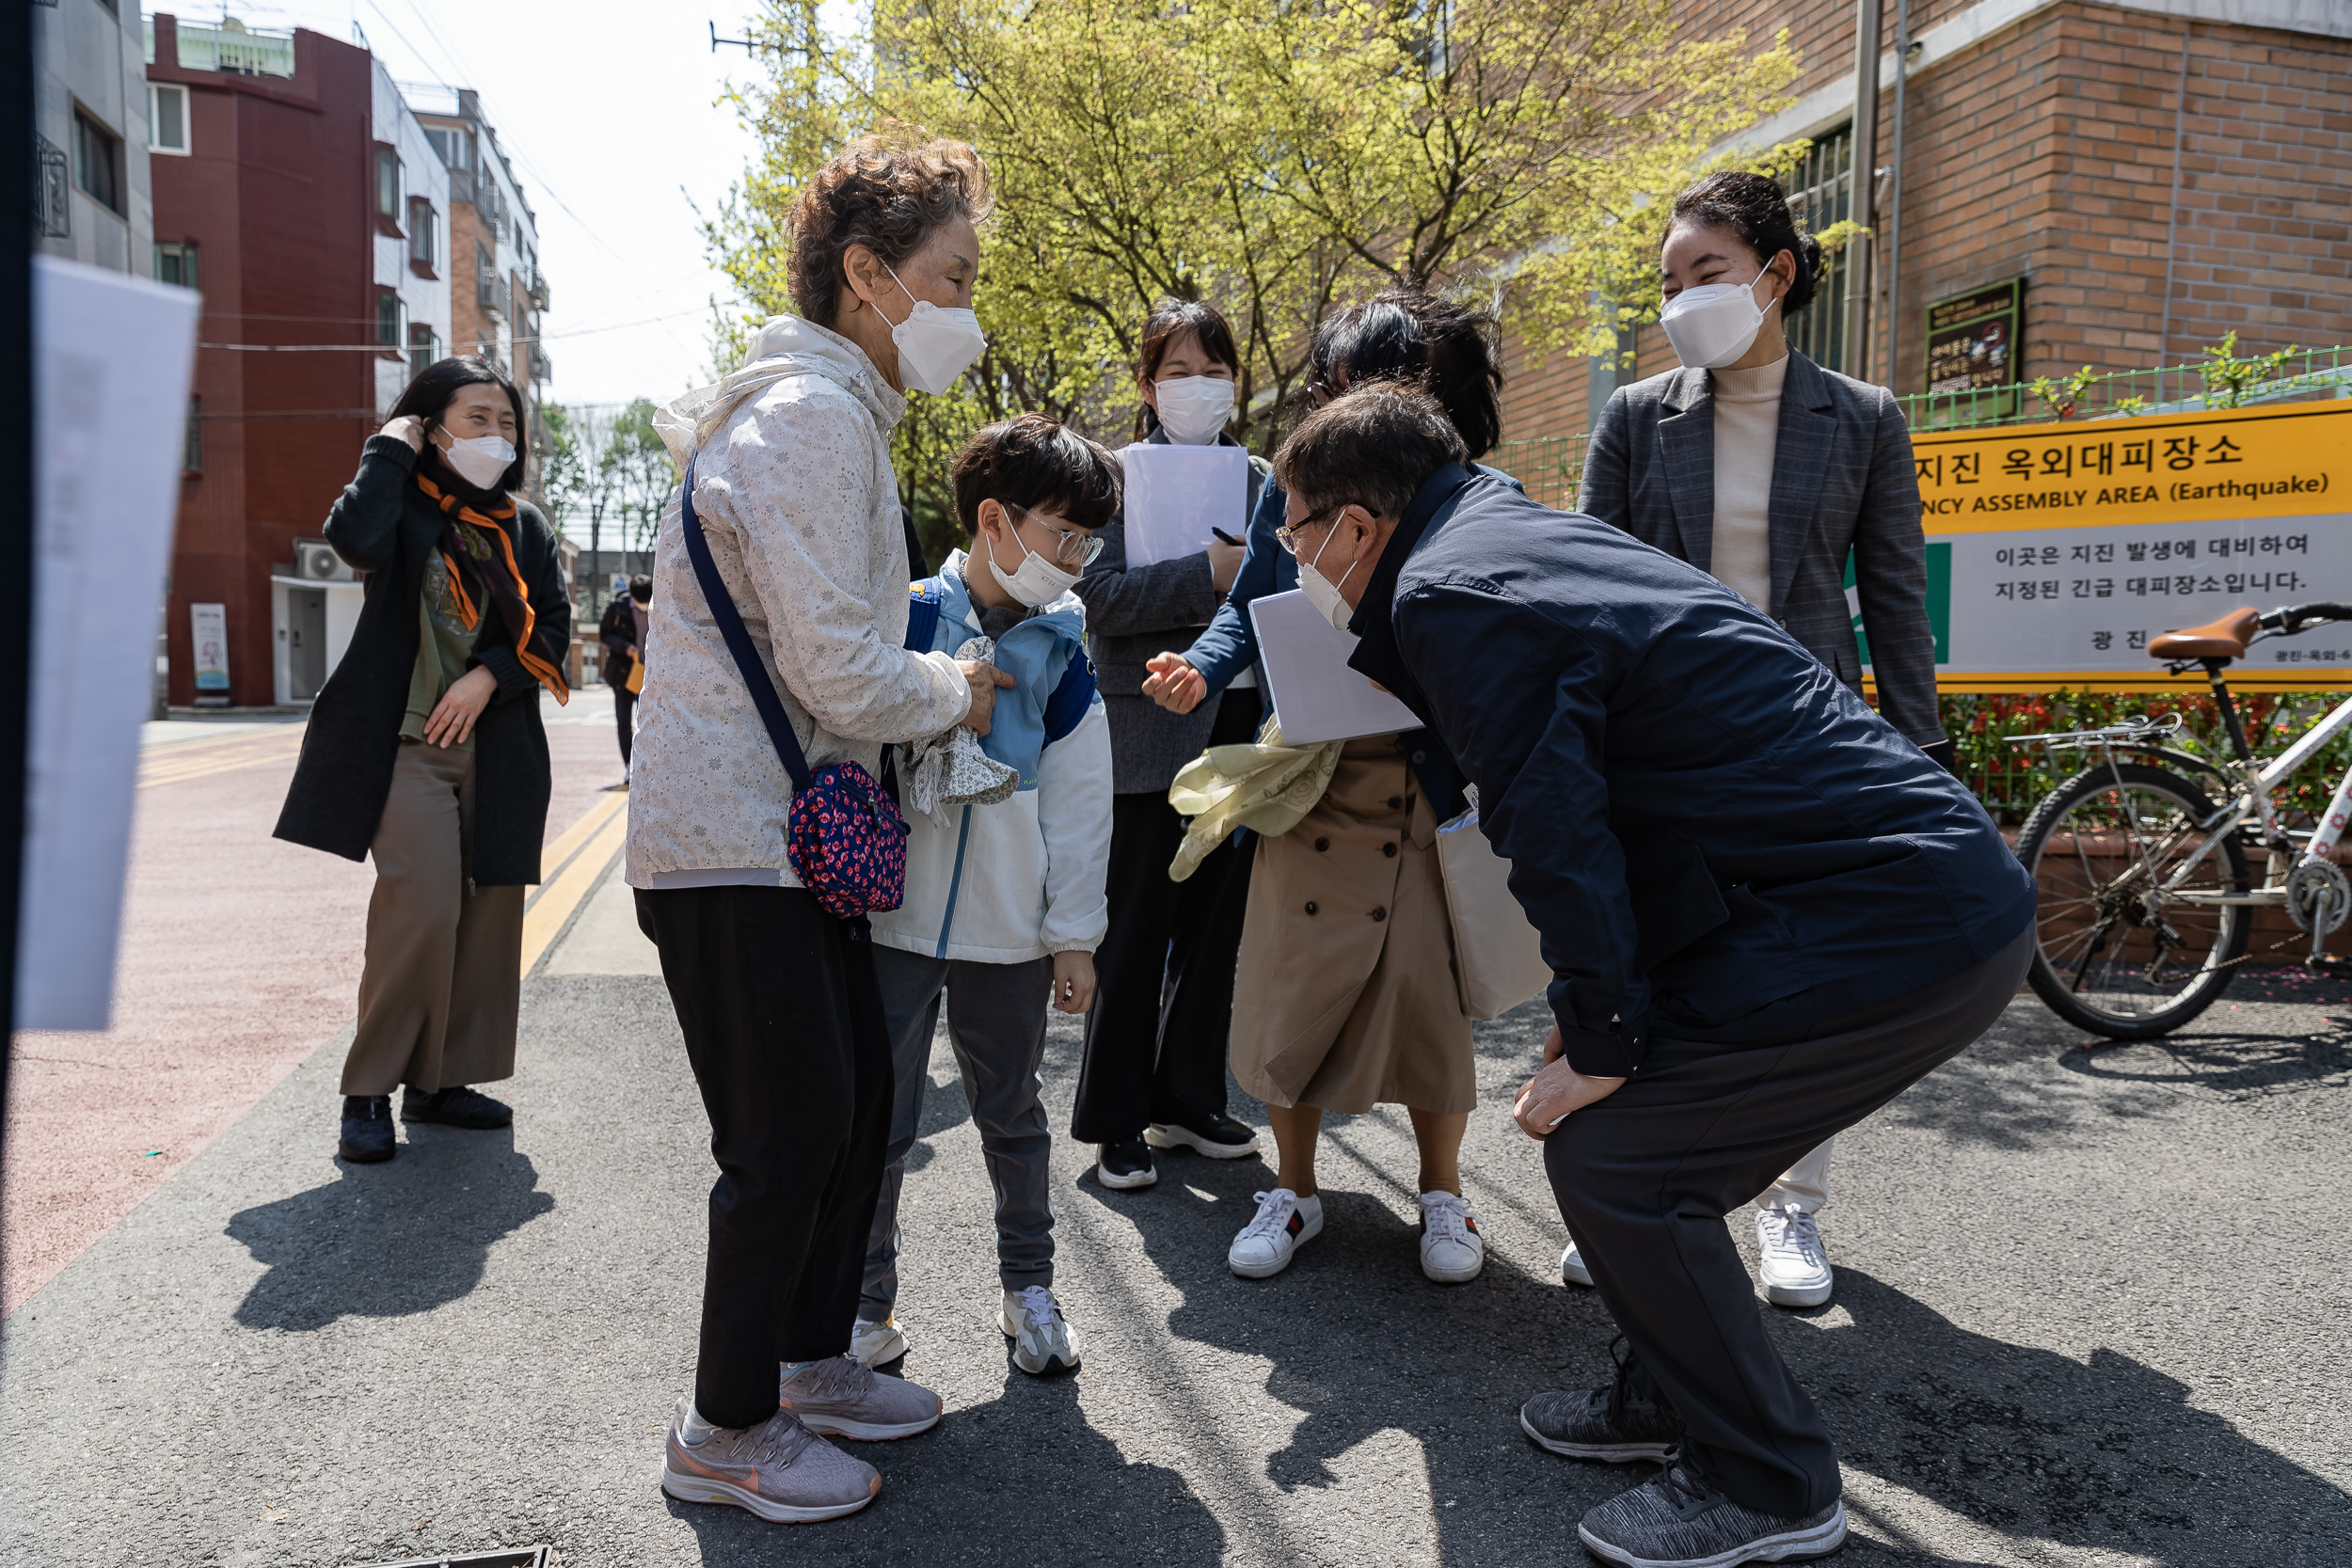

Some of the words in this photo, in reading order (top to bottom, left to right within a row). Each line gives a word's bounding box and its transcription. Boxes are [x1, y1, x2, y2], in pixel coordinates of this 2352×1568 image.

[1915, 452, 1979, 488] 지진
[2000, 436, 2242, 482] 옥외대피장소
[1972, 490, 2088, 513] ASSEMBLY
[2096, 485, 2159, 505] AREA
[2170, 473, 2328, 502] (Earthquake)
[1996, 546, 2059, 566] 이곳은
[2072, 544, 2113, 563] 지진
[2127, 540, 2196, 562] 발생에
[2209, 534, 2308, 558] 대비하여
[1041, 576, 1056, 587] KF94
[1996, 581, 2058, 600] 지정된
[2072, 578, 2114, 597] 긴급
[2126, 572, 2306, 596] 대피장소입니다.
[2091, 631, 2112, 650] 광
[2127, 631, 2146, 649] 진
